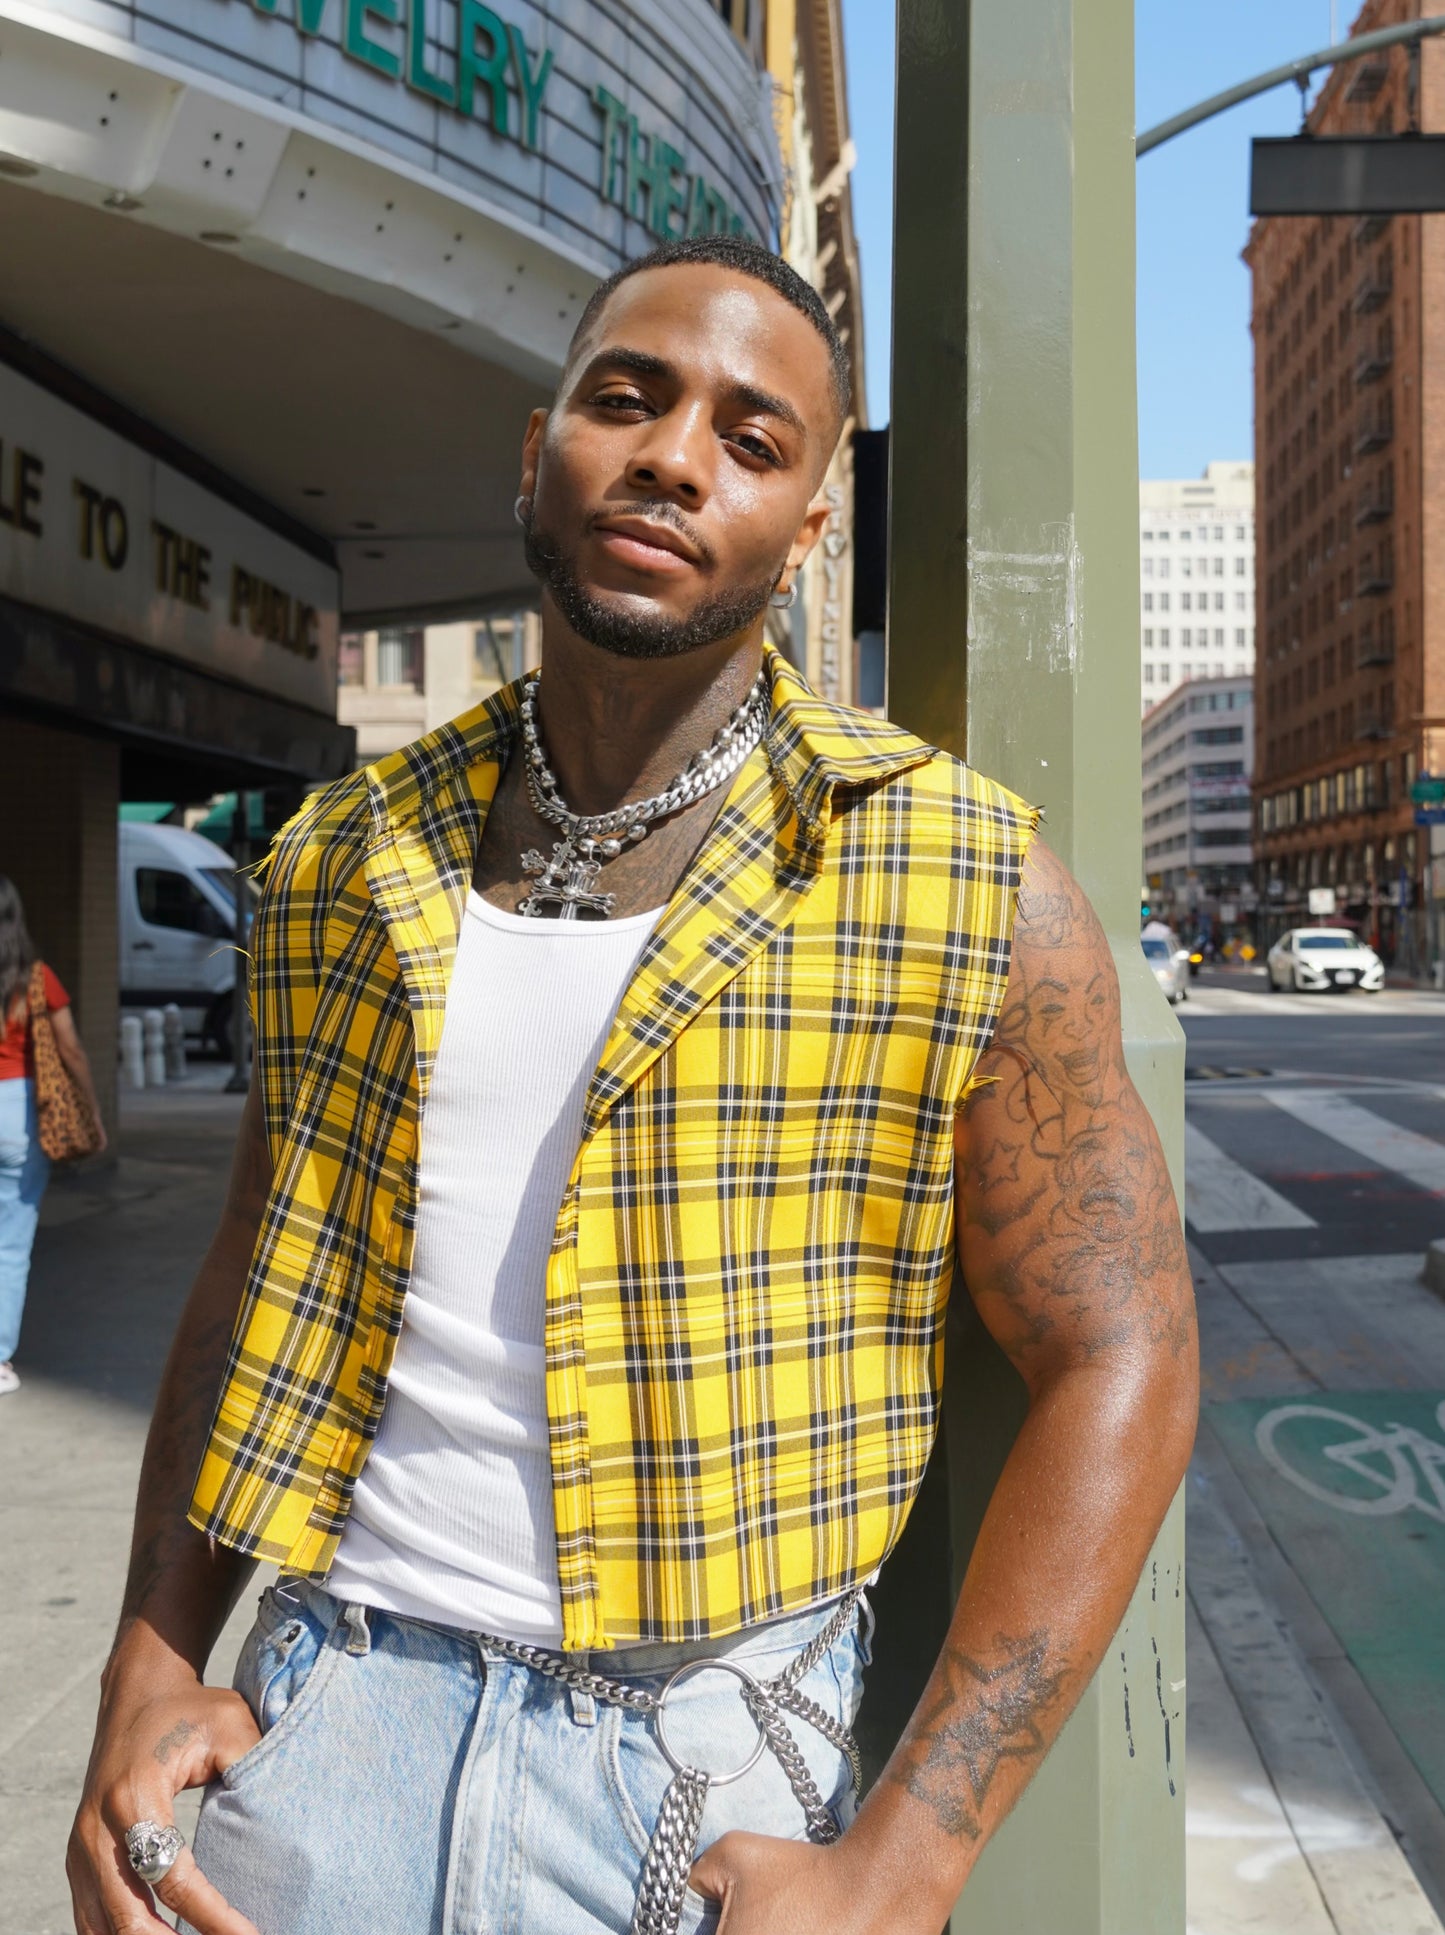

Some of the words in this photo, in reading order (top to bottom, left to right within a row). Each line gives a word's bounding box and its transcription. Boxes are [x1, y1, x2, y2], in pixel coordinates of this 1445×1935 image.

[252, 0, 554, 151] ELRY
[72, 477, 129, 572] TO
[152, 519, 212, 612] THE
[230, 563, 319, 661] PUBLIC
